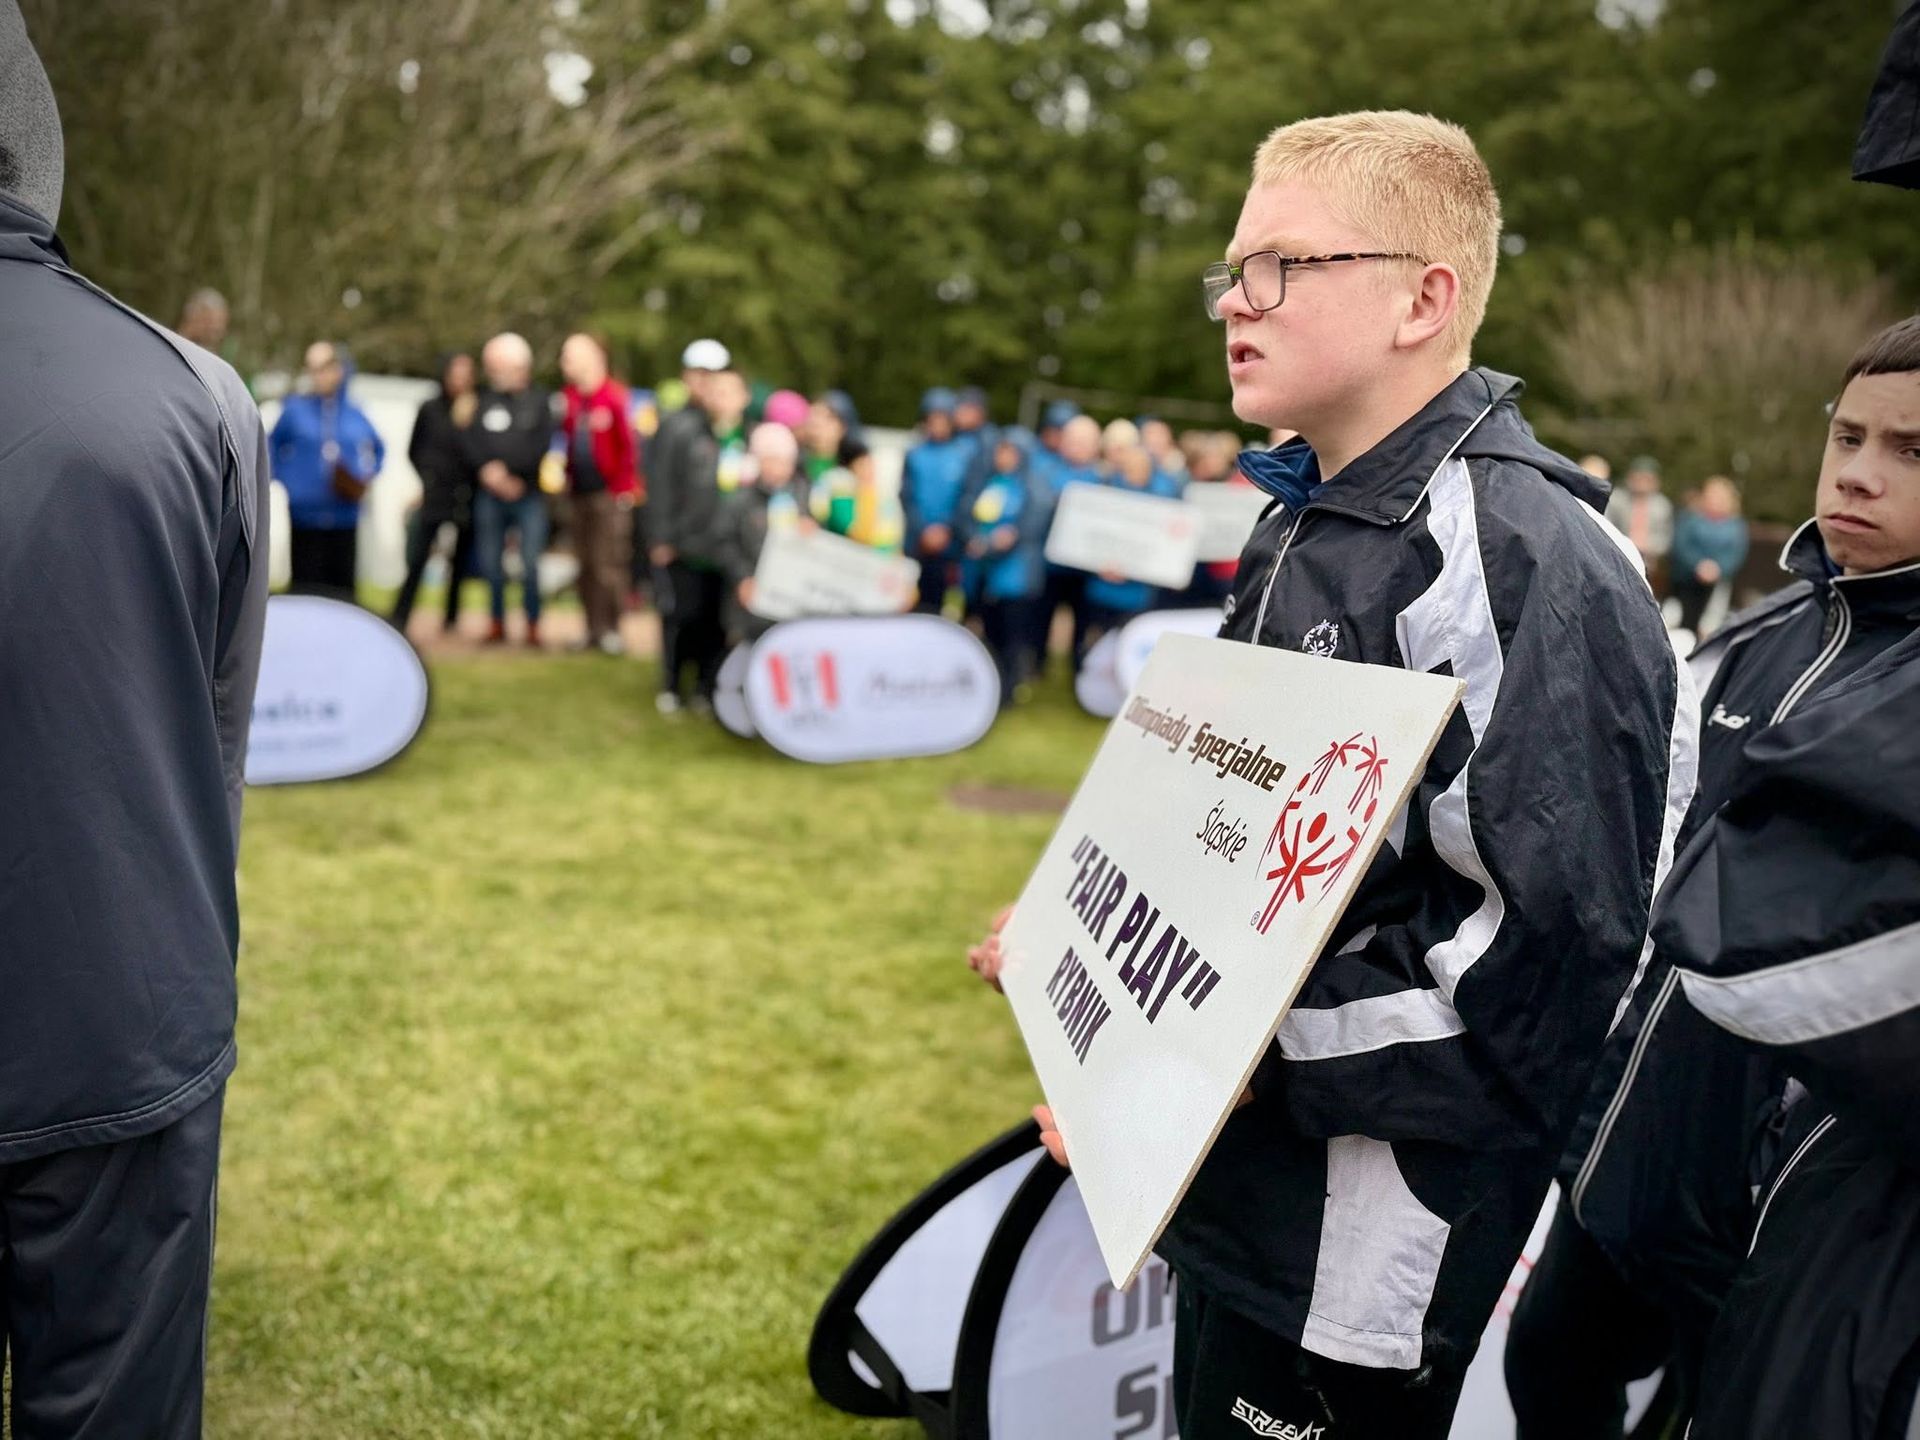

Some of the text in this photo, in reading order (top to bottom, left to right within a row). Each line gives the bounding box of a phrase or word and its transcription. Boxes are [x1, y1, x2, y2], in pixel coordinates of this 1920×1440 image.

[1188, 722, 1287, 792] Specjalne
[1196, 799, 1247, 863] Śląskie
[1046, 945, 1112, 1066] RYBNIK
